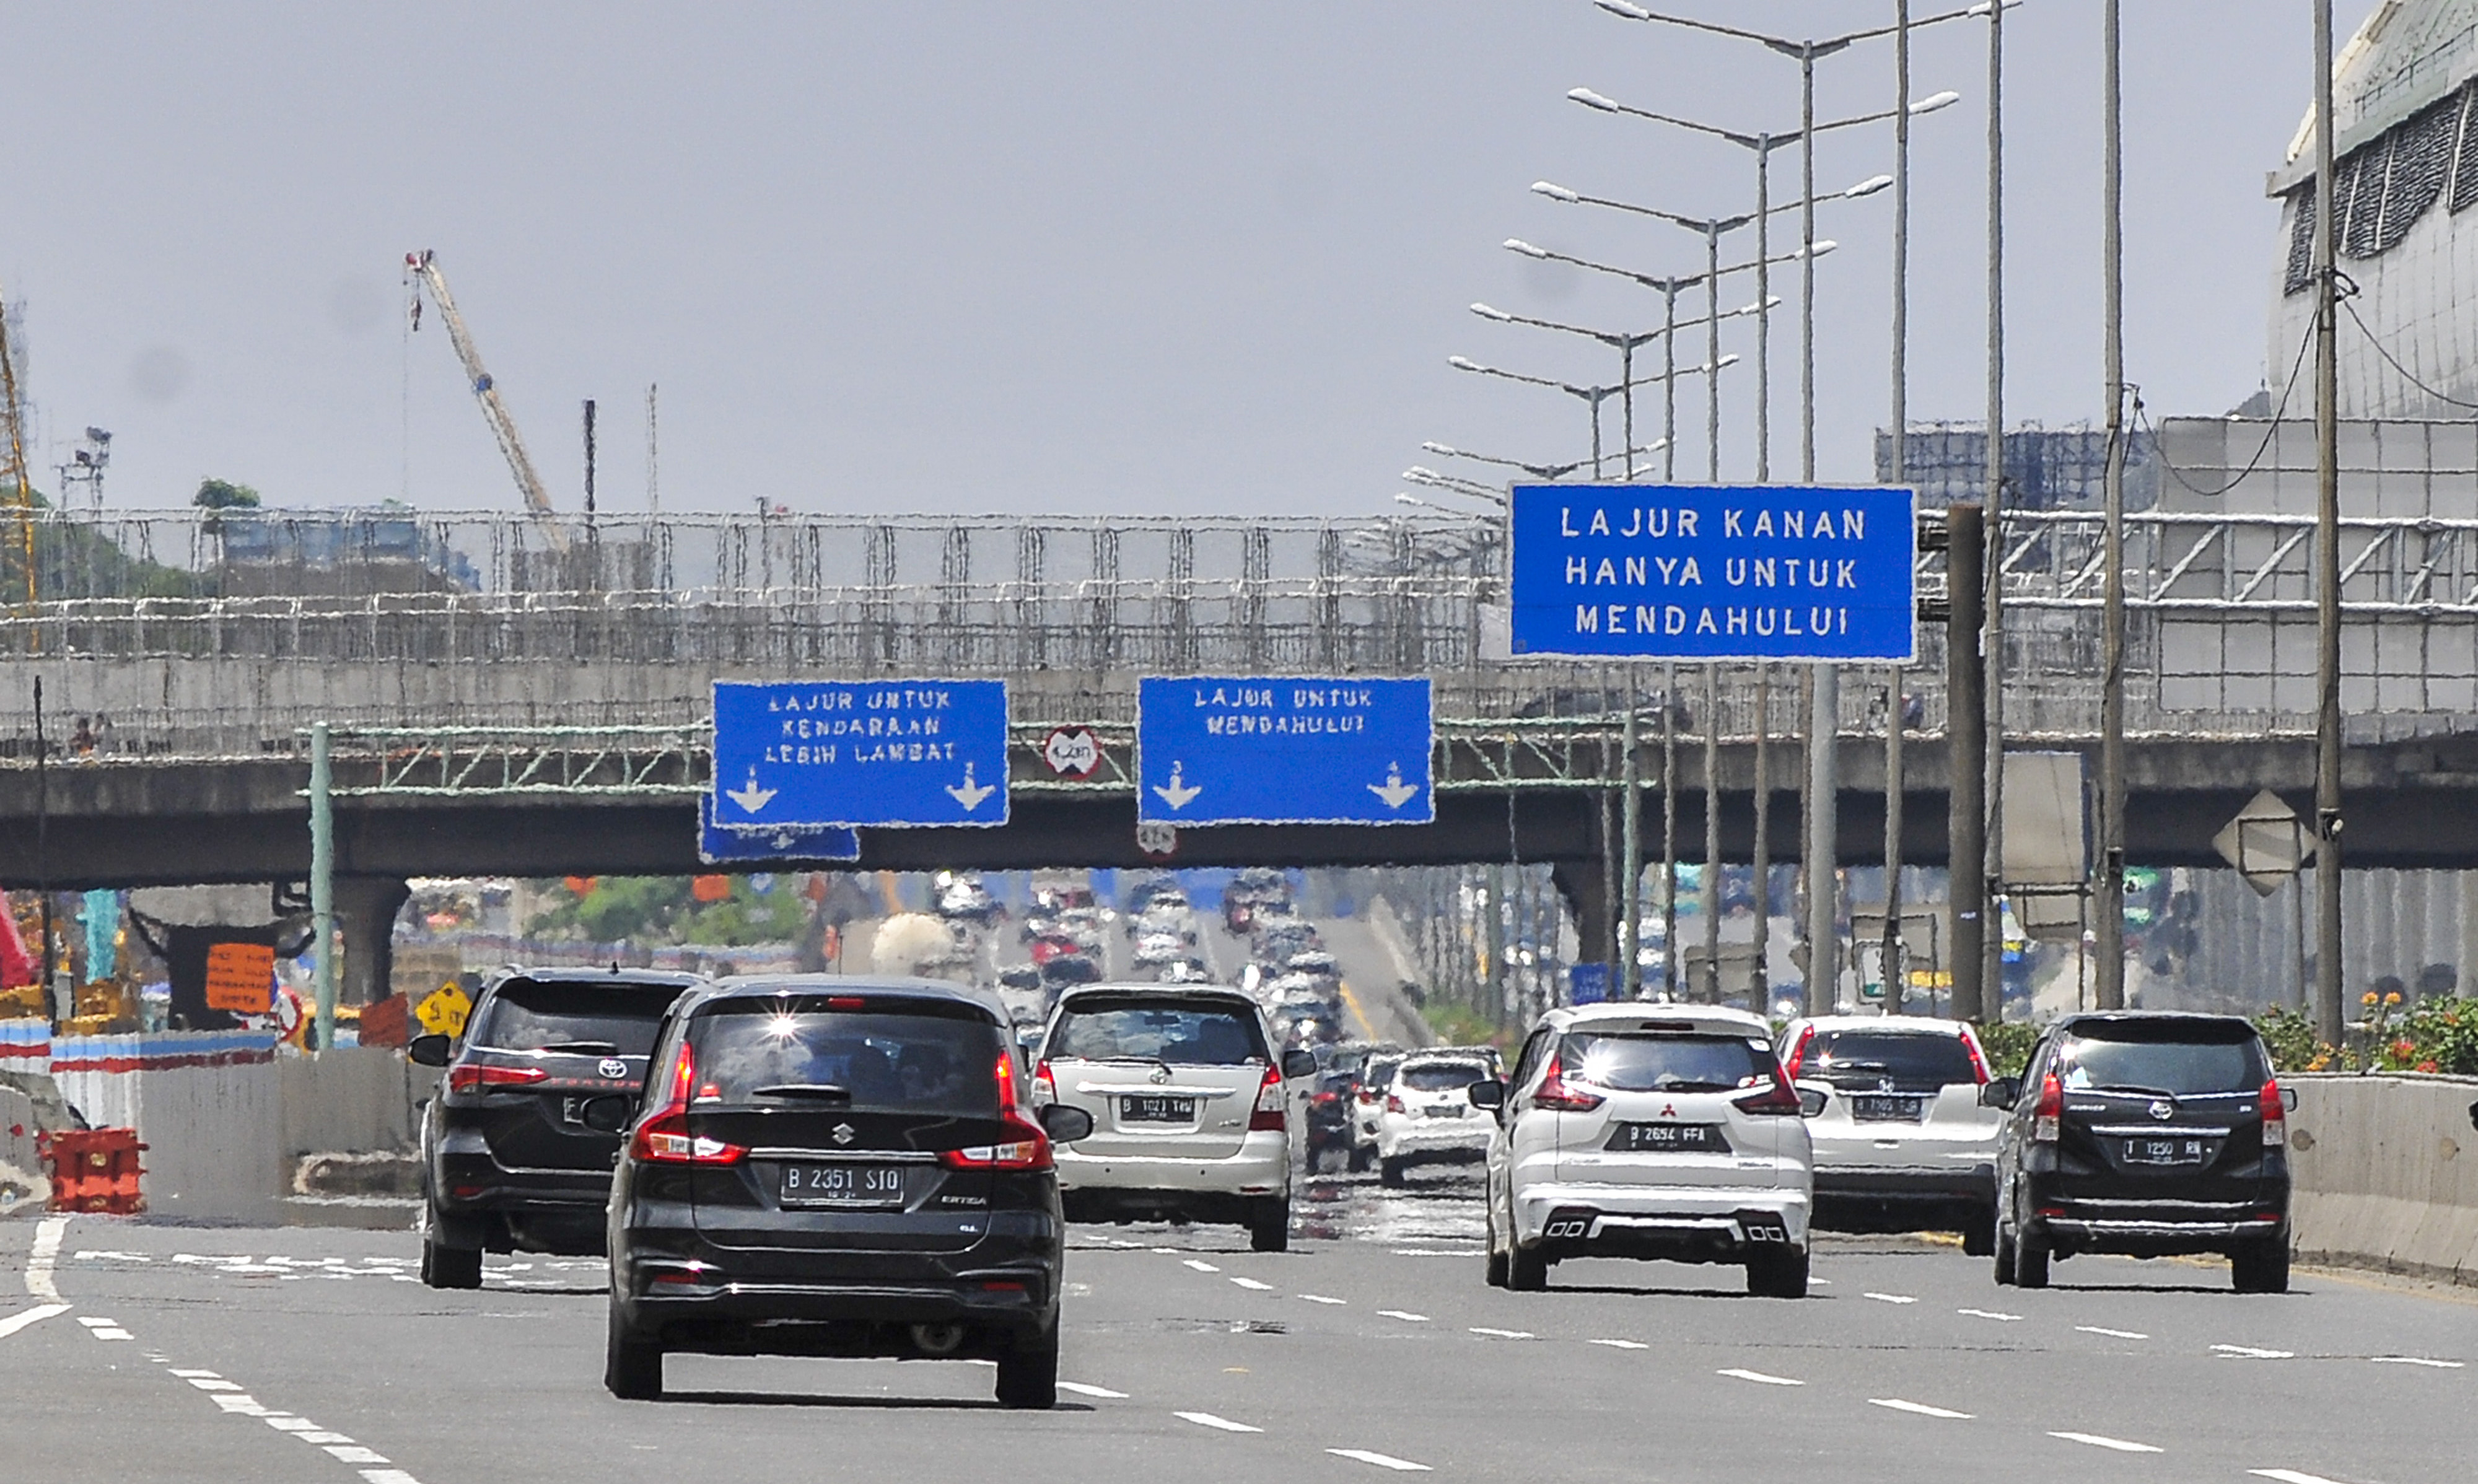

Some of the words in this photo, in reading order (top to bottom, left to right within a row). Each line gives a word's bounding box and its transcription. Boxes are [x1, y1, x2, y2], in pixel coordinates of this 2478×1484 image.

[1562, 508, 1698, 537] LAJUR
[1725, 509, 1863, 539] KANAN
[1566, 557, 1702, 586] HANYA
[1727, 558, 1855, 588] UNTUK
[1577, 605, 1846, 635] MENDAHULUI
[769, 693, 852, 711] LAJUR
[867, 691, 948, 709] UNTUK
[1195, 688, 1272, 707] LAJUR
[1294, 689, 1371, 708] UNTUK
[783, 717, 939, 738] KENDARAAN
[1207, 715, 1363, 735] MENDAHULUI
[766, 744, 835, 764] LEBIH
[856, 743, 953, 762] LAMBAT
[1172, 761, 1182, 775] 3
[1631, 1126, 1639, 1141] B
[788, 1168, 801, 1189] B
[810, 1168, 853, 1189] 2351
